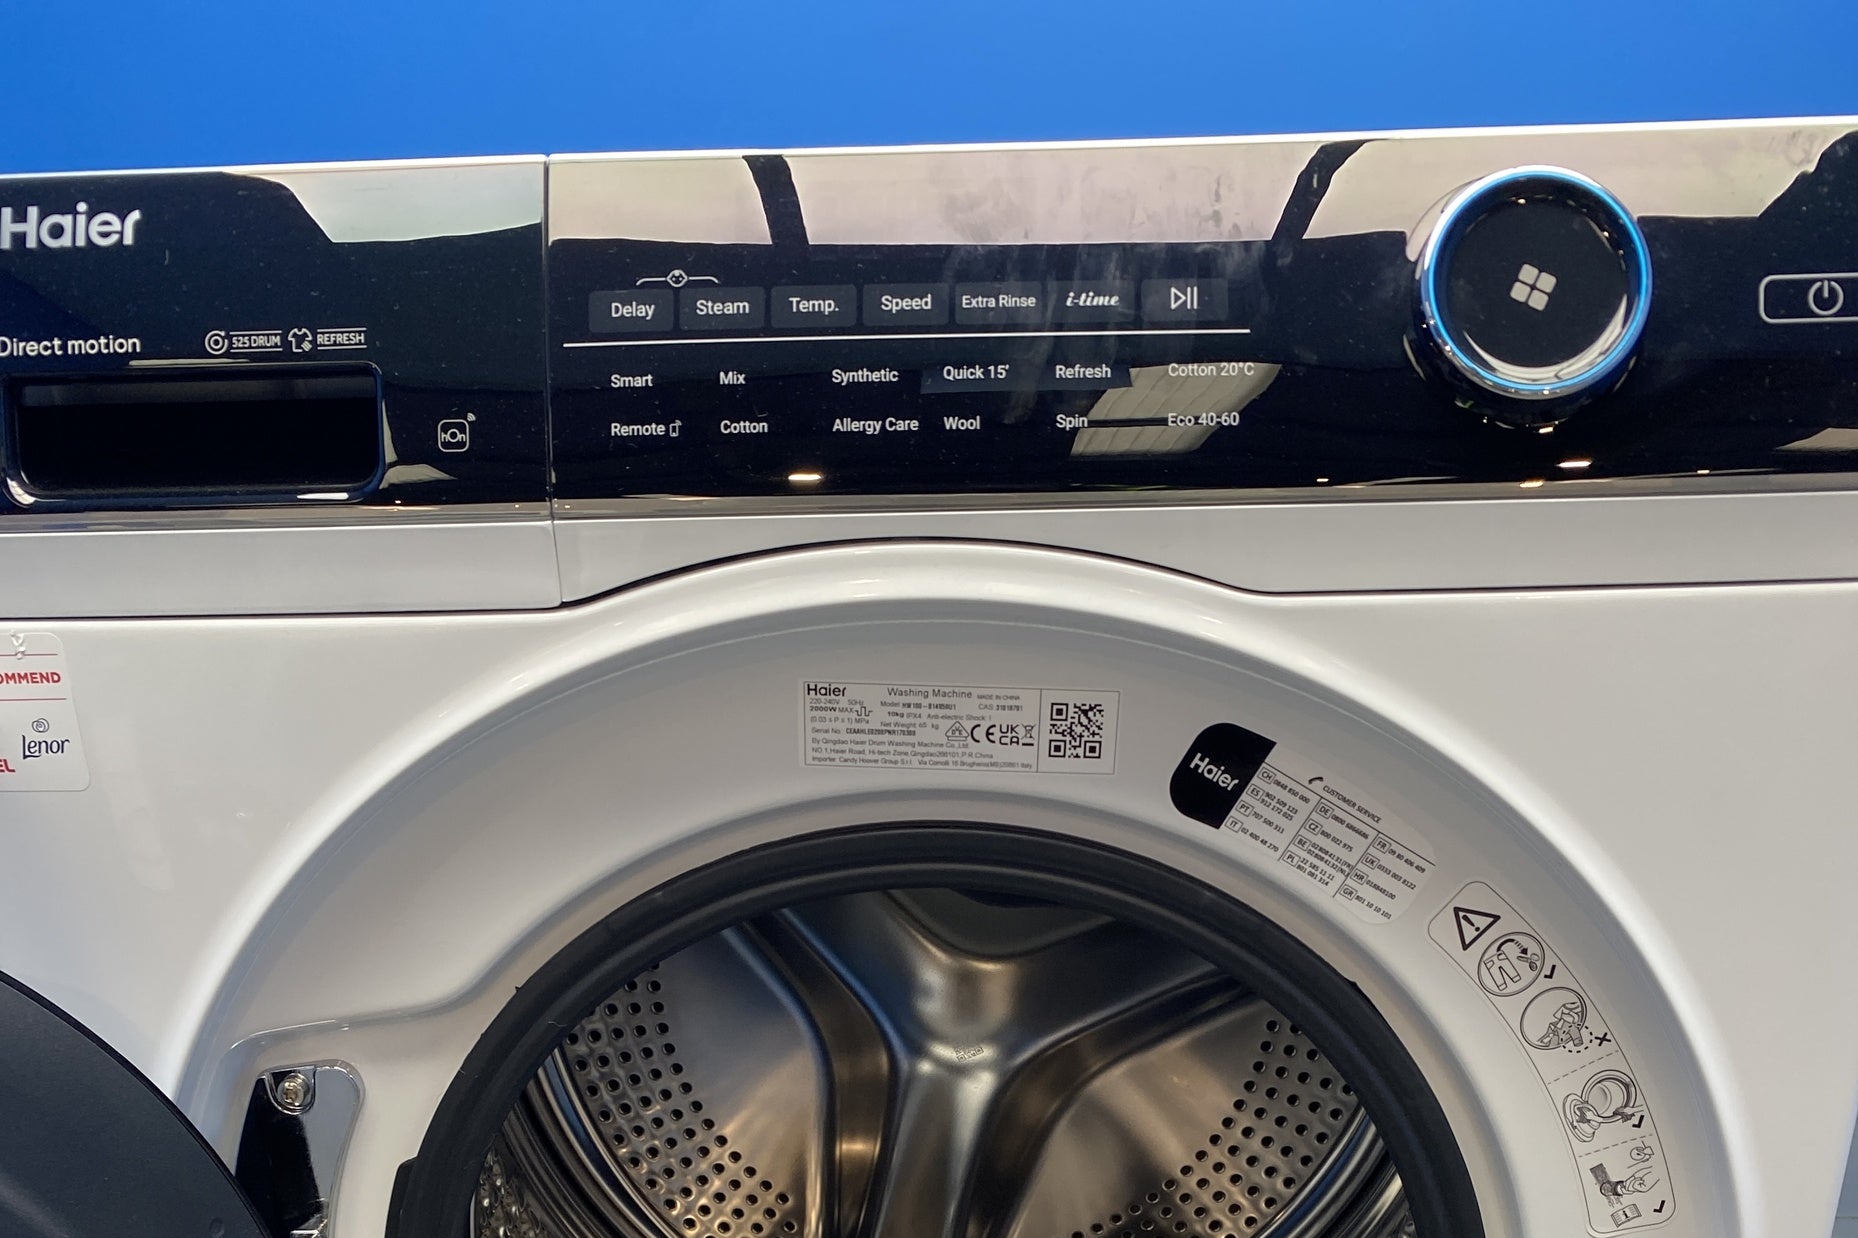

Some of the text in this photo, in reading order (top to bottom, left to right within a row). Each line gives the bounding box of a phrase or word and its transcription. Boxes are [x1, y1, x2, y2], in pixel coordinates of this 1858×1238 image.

[0, 201, 142, 249] Haier
[697, 300, 750, 314] Steam
[789, 298, 839, 315] Temp.
[880, 294, 932, 312] Speed
[962, 295, 1036, 308] Extra Rinse
[611, 302, 654, 319] Delay
[0, 335, 140, 356] Direct motion
[232, 335, 281, 348] 525 DRUM
[317, 333, 365, 345] REFRESH
[943, 365, 984, 380] Quick
[1056, 364, 1111, 378] Refresh
[1168, 362, 1254, 376] Cotton 20°C
[611, 374, 652, 388] Smart
[720, 371, 745, 384] Mix
[832, 368, 899, 385] Synthetic
[833, 418, 919, 434] Allergy Care
[944, 415, 980, 430] Wool
[1056, 414, 1088, 429] Spin
[1168, 412, 1239, 426] Eco 40-60
[611, 422, 665, 436] Remote
[720, 420, 768, 433] Cotton
[807, 684, 846, 696] Haier
[888, 688, 972, 699] Washing Machine
[1000, 724, 1020, 734] UK
[22, 734, 70, 760] Lenor
[888, 740, 915, 748] Washing
[1000, 736, 1019, 746] CA
[1190, 753, 1239, 791] Haier
[1261, 770, 1272, 780] CH
[1298, 794, 1310, 804] 000
[1251, 788, 1298, 814] ES 902 509 123
[1322, 785, 1382, 824] CUSTOMER SERVICE
[1240, 804, 1249, 813] PT
[1252, 811, 1263, 820] 707
[1263, 818, 1274, 827] 500
[1272, 805, 1283, 814] 172
[1319, 806, 1330, 816] DE
[1230, 820, 1238, 828] IT
[1267, 843, 1279, 852] 270
[1308, 822, 1318, 832] CZ
[1331, 836, 1342, 845] 022
[1297, 838, 1307, 847] BE
[1377, 840, 1387, 850] FR
[1286, 854, 1296, 863] PL
[1365, 856, 1376, 867] UK
[1377, 864, 1392, 875] 0333
[1353, 872, 1364, 882] HR
[1342, 887, 1354, 897] GR
